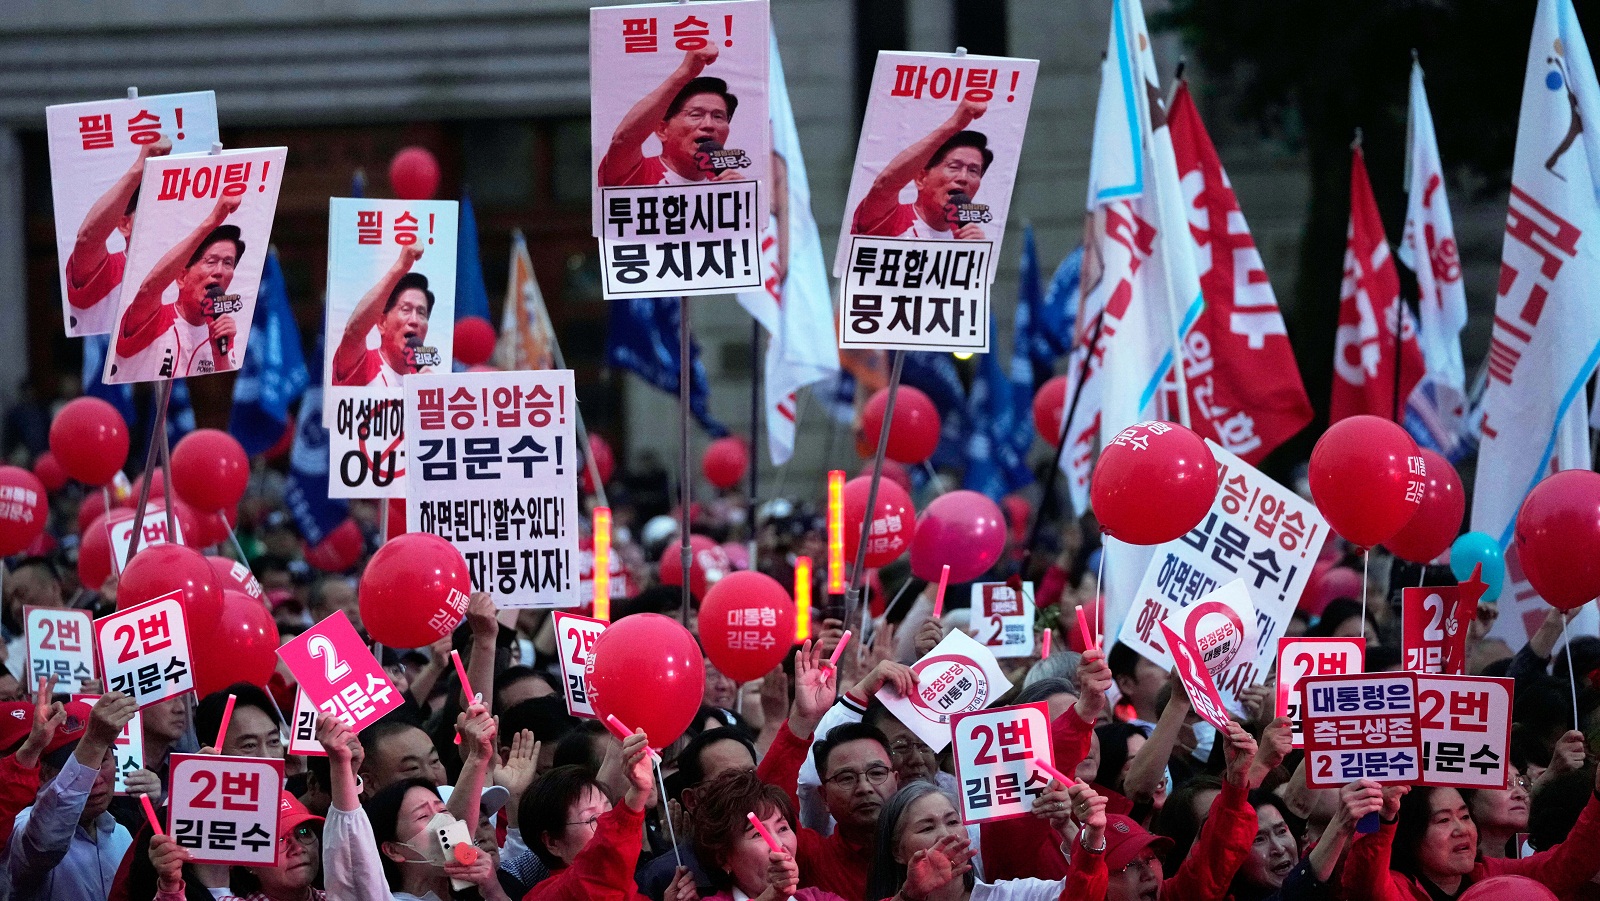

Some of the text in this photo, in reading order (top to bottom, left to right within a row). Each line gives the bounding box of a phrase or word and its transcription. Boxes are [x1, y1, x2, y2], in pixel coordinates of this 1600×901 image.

[711, 155, 751, 170] 김문수
[609, 191, 750, 238] 투표합시다!
[958, 210, 992, 223] 김문수
[612, 239, 752, 284] 뭉치자!
[852, 247, 984, 289] 투표합시다!
[849, 294, 977, 337] 뭉치자!
[418, 384, 565, 431] 필승!압승!
[340, 450, 405, 488] OU
[418, 436, 564, 482] 김문수!
[1408, 456, 1426, 477] 대통
[1218, 463, 1318, 558] 승!압승!
[1405, 481, 1425, 504] 김문
[421, 497, 564, 543] 하면된다!할수있다!
[465, 548, 570, 595] 자!뭉치자!
[446, 588, 470, 615] 대통
[727, 607, 776, 626] 대통령
[1424, 593, 1444, 641] 2
[38, 618, 80, 653] 2번
[114, 611, 172, 663] 2번
[428, 608, 458, 636] 김문
[1198, 622, 1234, 651] 정정당당
[306, 634, 352, 684] 2
[1203, 640, 1231, 662] 대통령
[32, 657, 91, 686] 김문수
[110, 655, 188, 698] 김문수
[921, 664, 963, 701] 정정당당
[320, 672, 393, 727] 김문수
[938, 677, 972, 710] 대통령
[1312, 683, 1411, 712] 대통령은
[1420, 688, 1489, 731] 2번
[970, 718, 1033, 765] 2번
[1314, 716, 1413, 746] 측근생존
[1317, 752, 1414, 778] 2 김문수
[1421, 742, 1499, 774] 문수
[189, 770, 259, 812] 2번
[966, 772, 1048, 811] 김문수
[175, 818, 270, 854] 김문수
